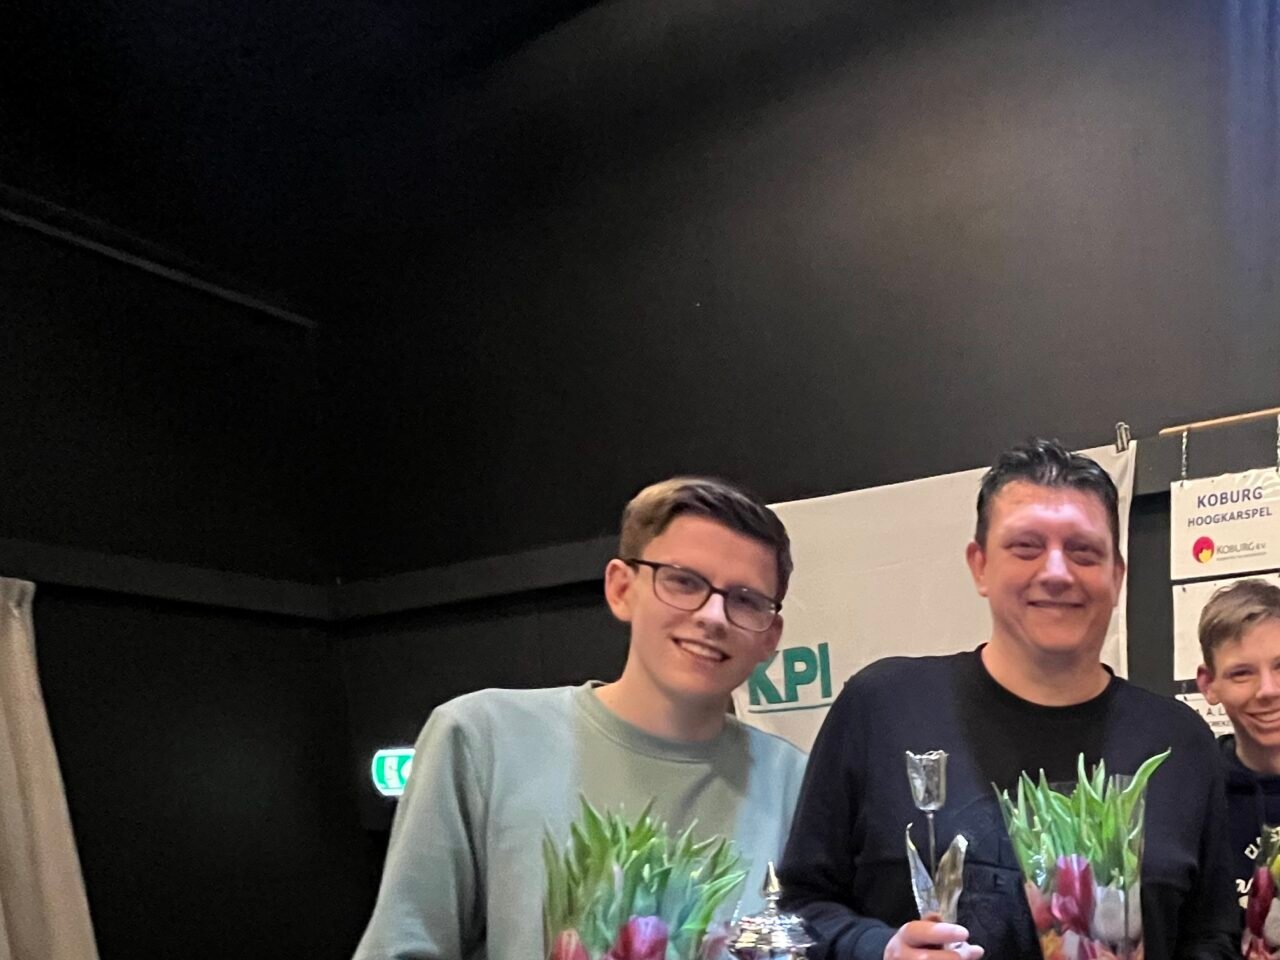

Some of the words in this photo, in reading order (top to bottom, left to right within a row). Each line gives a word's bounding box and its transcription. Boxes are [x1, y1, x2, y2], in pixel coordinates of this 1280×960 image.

[1197, 486, 1263, 509] KOBURG
[1187, 507, 1273, 528] HOOGKARSPEL
[746, 642, 832, 705] KPI
